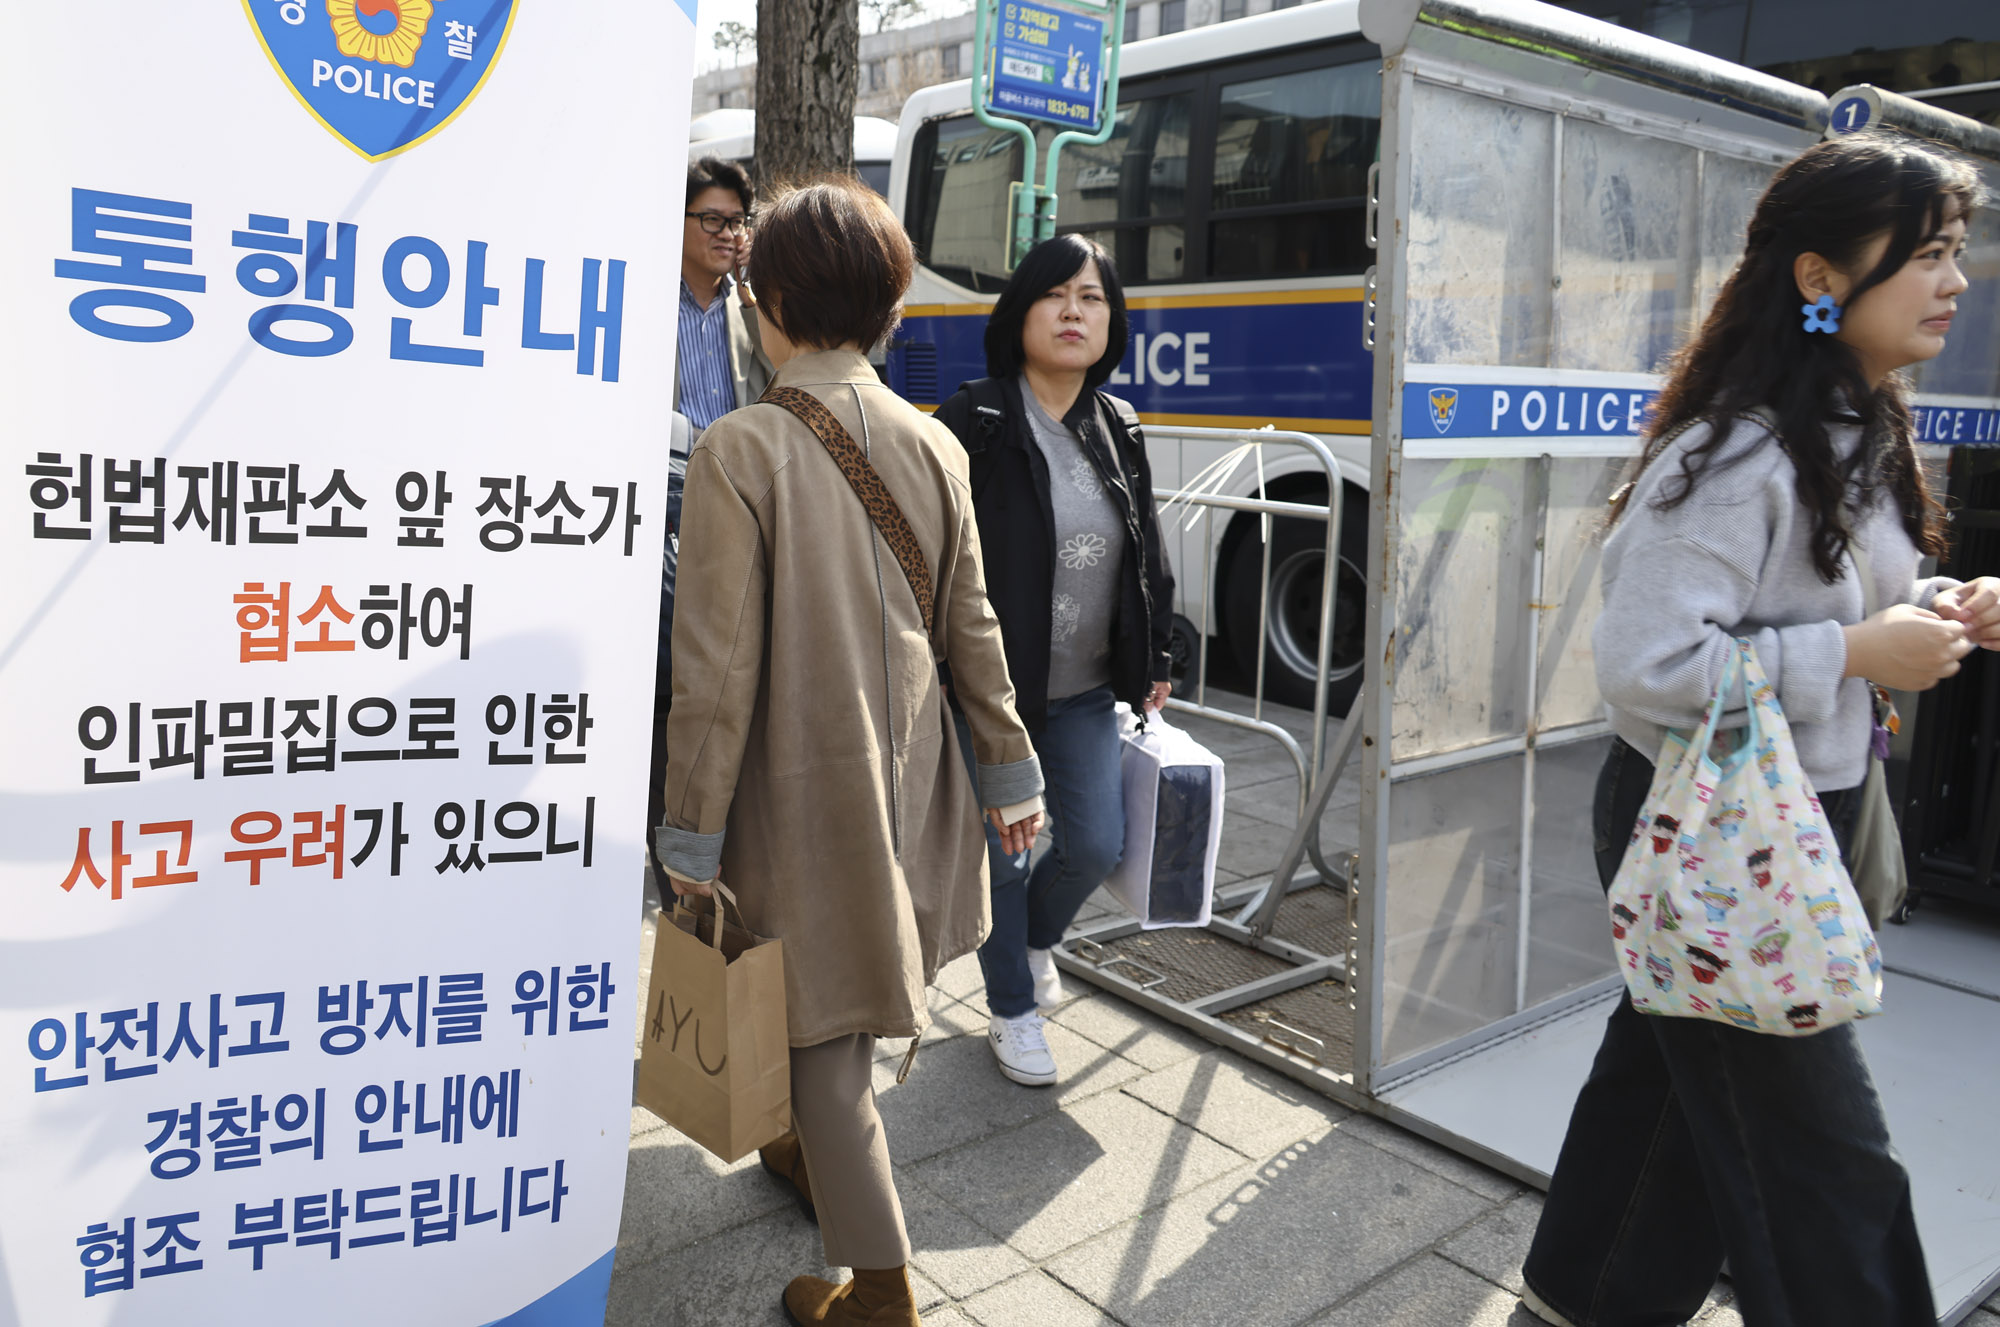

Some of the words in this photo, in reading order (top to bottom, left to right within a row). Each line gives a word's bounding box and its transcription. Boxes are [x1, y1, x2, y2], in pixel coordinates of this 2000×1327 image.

[312, 59, 435, 109] POLICE
[444, 20, 477, 61] 찰
[1844, 102, 1858, 128] 1
[54, 187, 627, 383] 통행안내
[1491, 389, 1643, 432] POLICE
[1912, 409, 1965, 441] LICE
[1974, 411, 2000, 441] LI
[25, 452, 368, 546] 헌법재판소
[395, 470, 453, 548] 앞
[475, 474, 642, 557] 장소가
[233, 581, 474, 663] 협소하여
[78, 694, 460, 785] 인파밀집으로
[485, 692, 594, 766] 인한
[60, 819, 198, 900] 사고
[224, 801, 409, 886] 우려가
[434, 796, 596, 875] 있으니
[27, 991, 290, 1093] 안전사고
[317, 972, 488, 1056] 방지를
[511, 961, 616, 1037] 위한
[651, 989, 727, 1077] AYU
[144, 1087, 326, 1180] 경찰의
[354, 1068, 521, 1154] 안내에
[76, 1211, 204, 1298] 협조
[228, 1159, 569, 1271] 부탁드립니다
